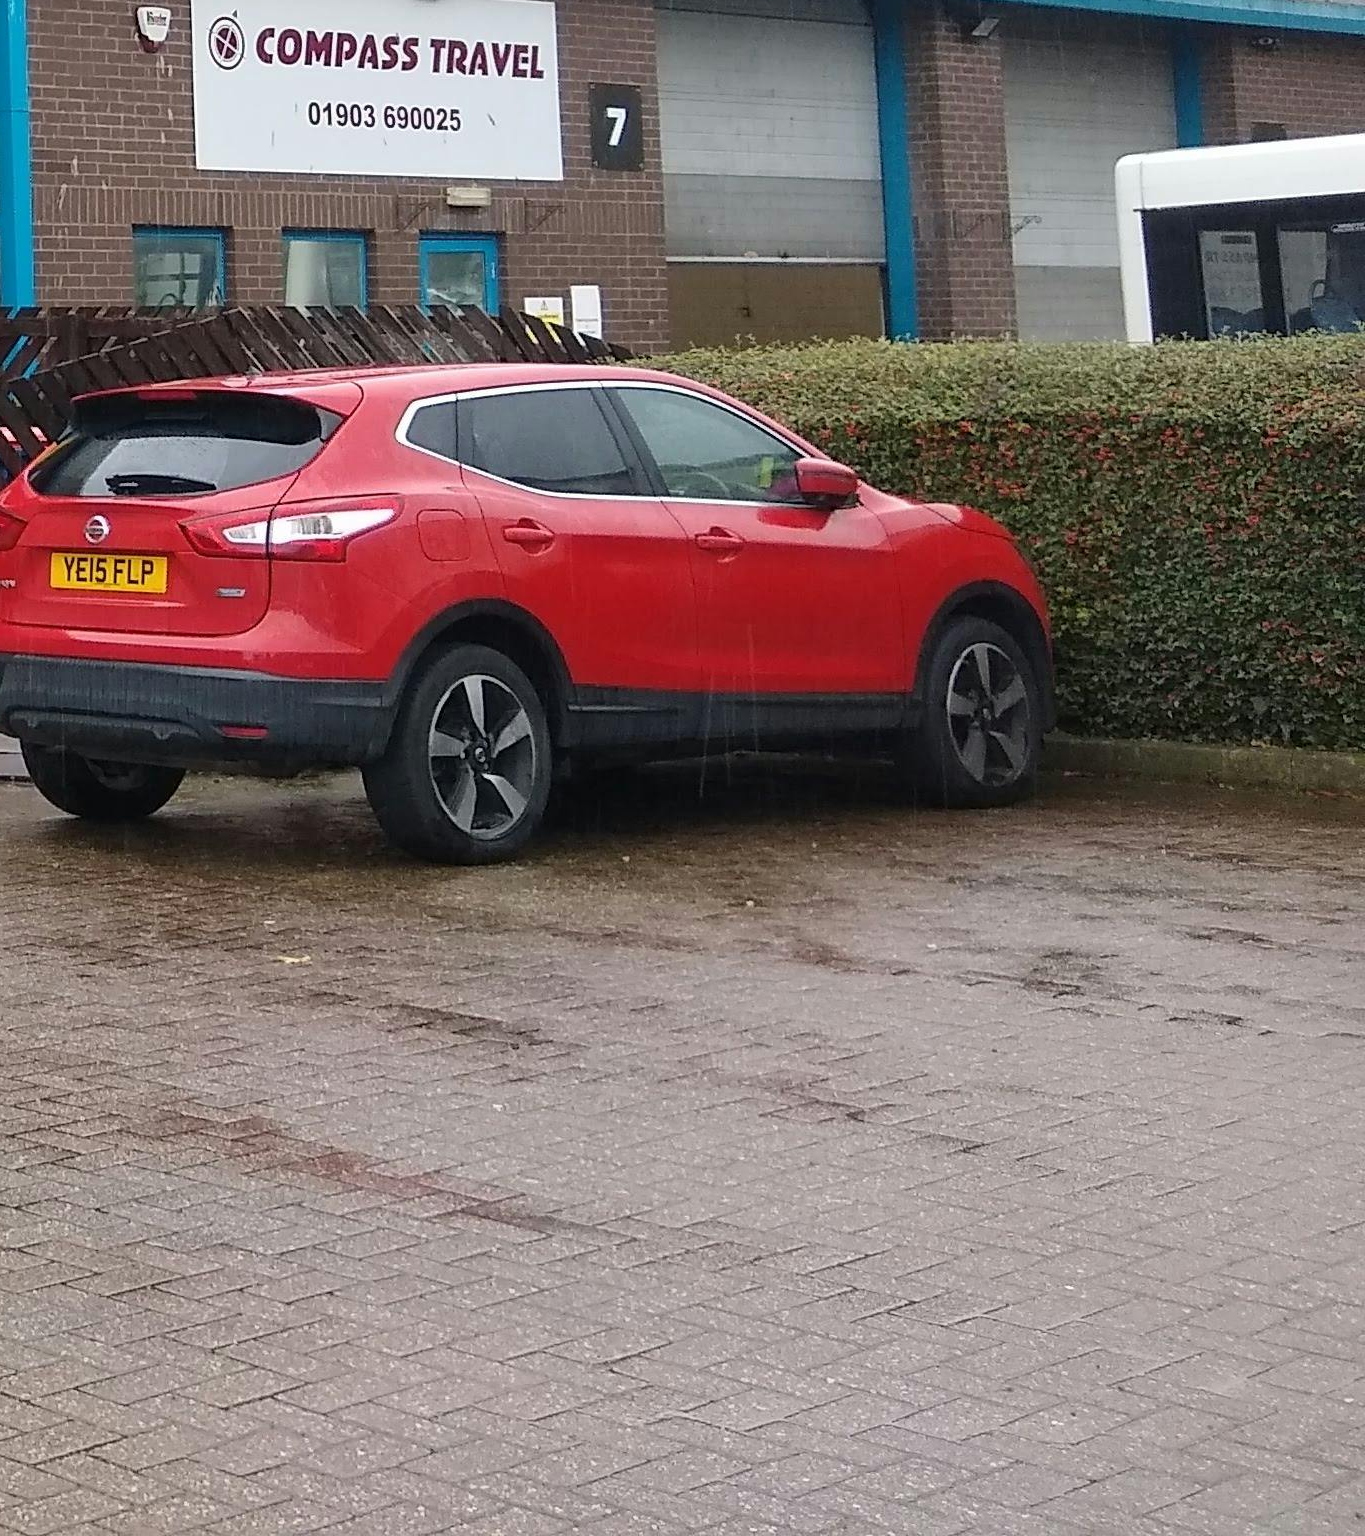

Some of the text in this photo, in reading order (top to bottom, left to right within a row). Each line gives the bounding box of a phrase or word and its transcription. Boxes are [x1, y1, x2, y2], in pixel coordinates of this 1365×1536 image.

[255, 27, 544, 79] COMPASS TRAVEL
[308, 101, 461, 132] 01903 690025
[605, 107, 627, 146] 7
[64, 556, 154, 585] YE15 FLP
